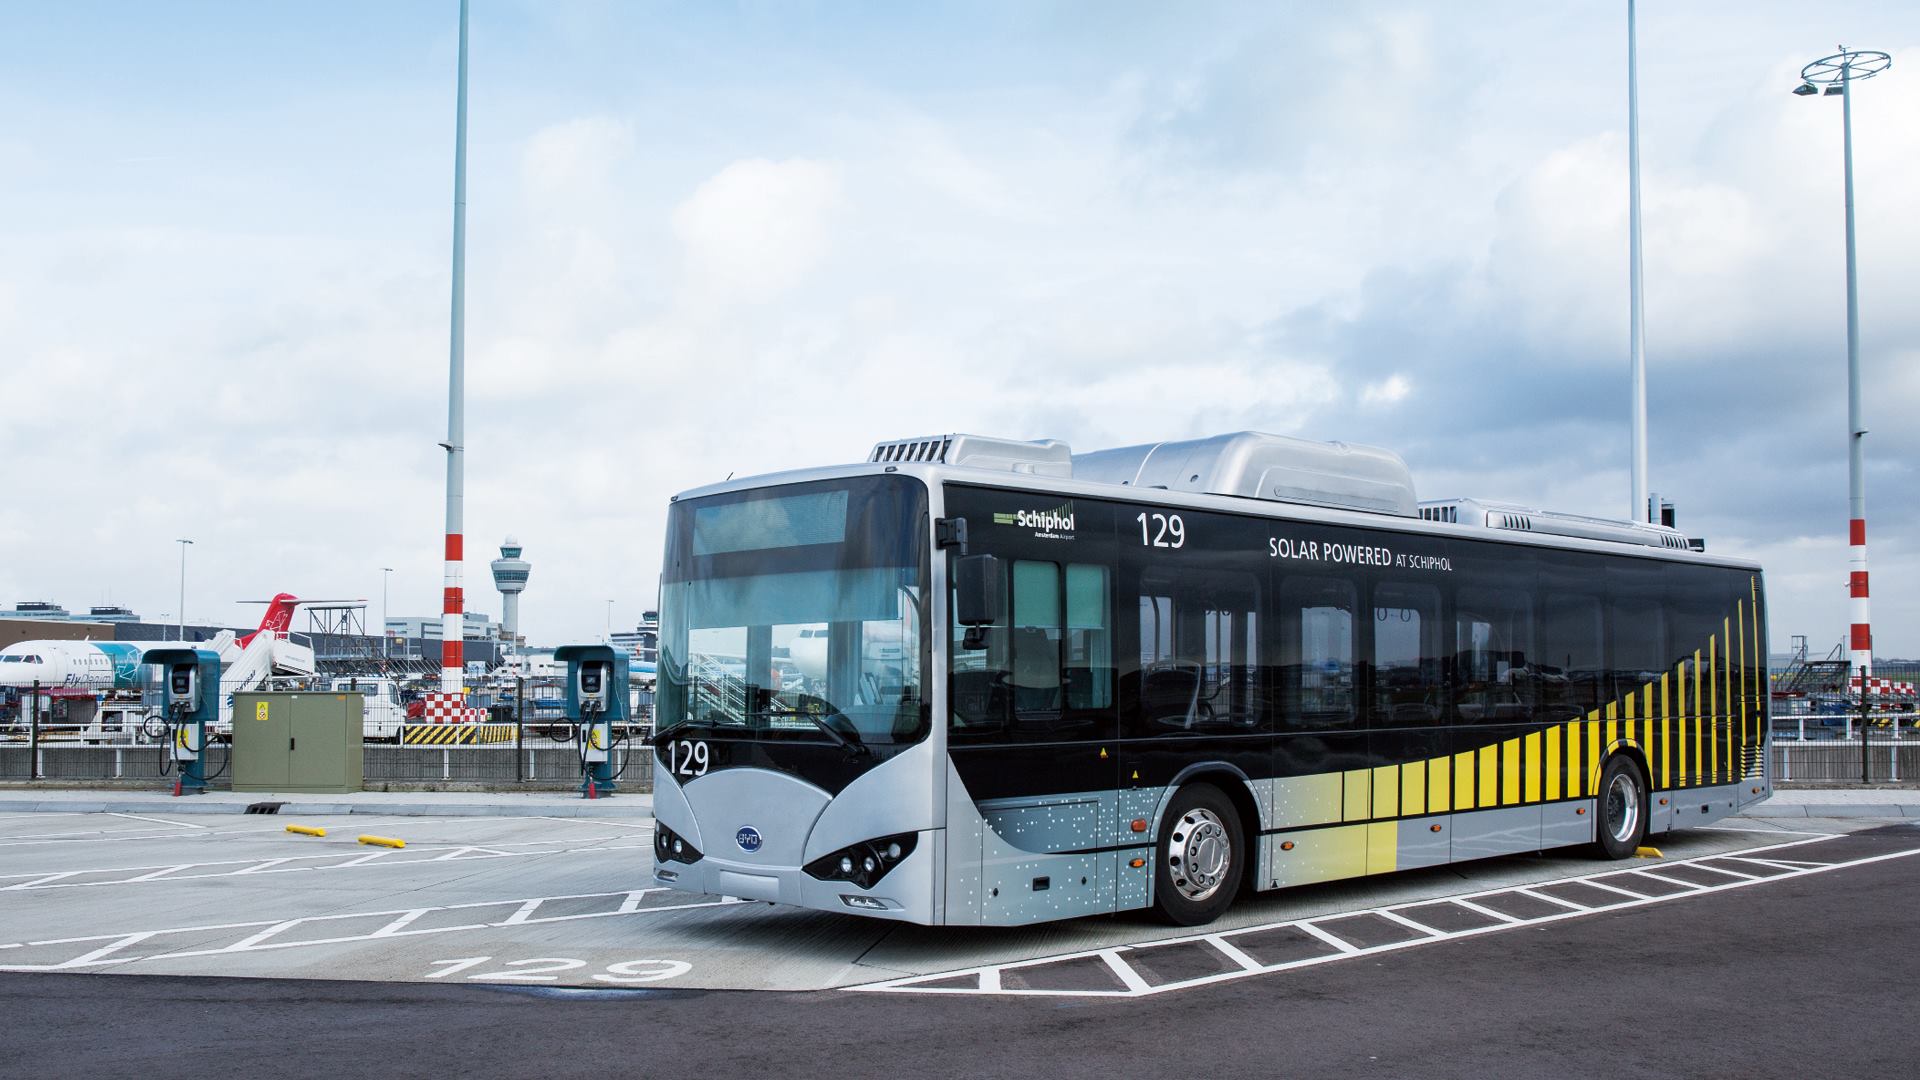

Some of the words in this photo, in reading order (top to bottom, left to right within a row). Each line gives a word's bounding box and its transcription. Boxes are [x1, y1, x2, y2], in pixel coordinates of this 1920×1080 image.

[1017, 509, 1075, 532] Schiphol
[1136, 512, 1186, 549] 129
[1269, 537, 1319, 560] SOLAR
[1323, 542, 1392, 566] POWERED
[1395, 553, 1407, 568] AT
[1409, 554, 1452, 571] SCHIPHOL
[668, 740, 709, 775] 129
[738, 833, 758, 845] BYD
[424, 956, 692, 983] 129
